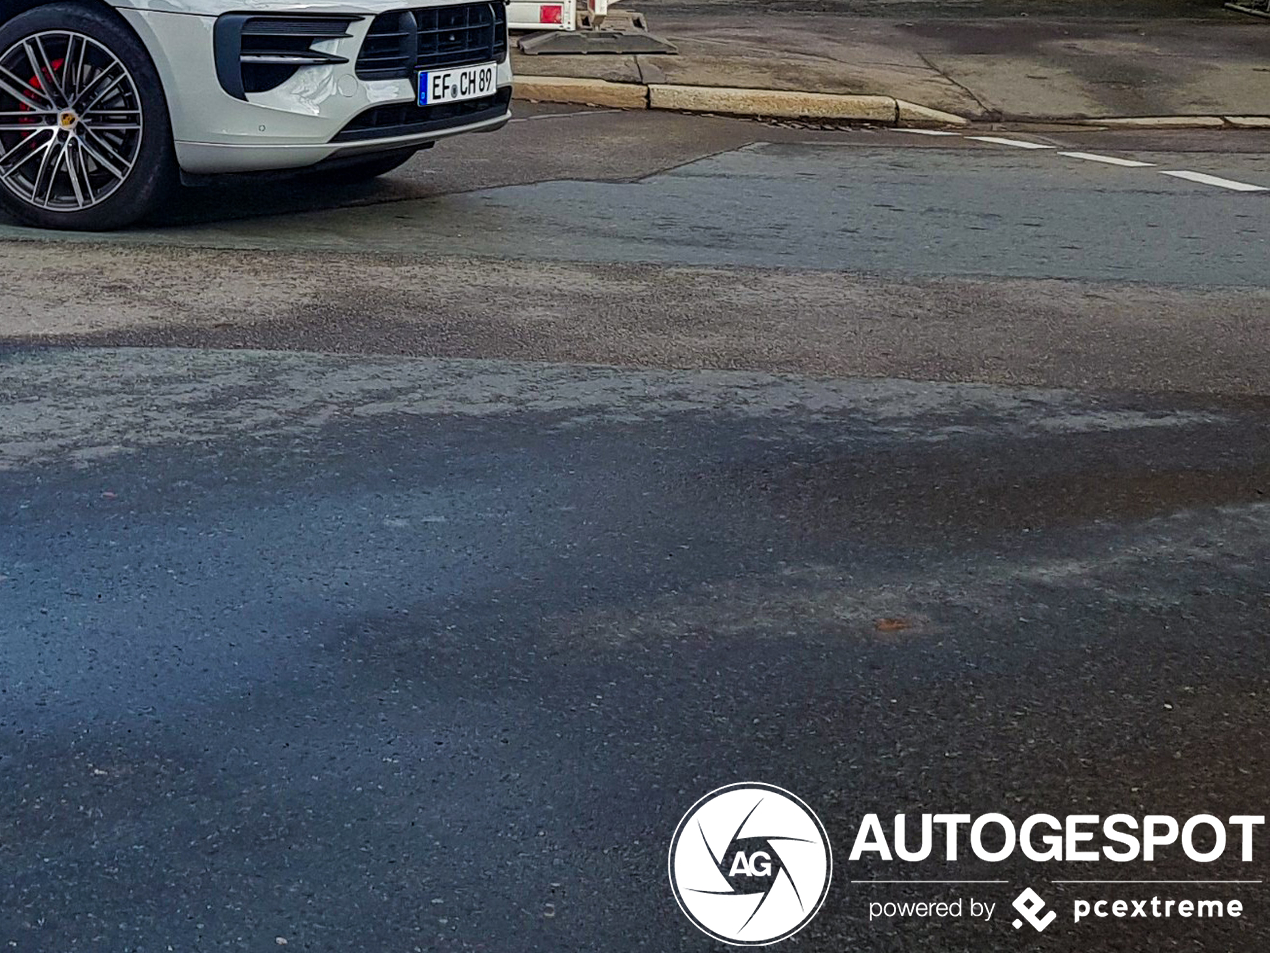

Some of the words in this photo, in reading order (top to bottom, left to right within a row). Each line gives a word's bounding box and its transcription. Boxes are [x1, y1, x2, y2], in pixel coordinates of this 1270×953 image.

[432, 73, 452, 101] EF
[459, 69, 477, 96] CH
[478, 67, 493, 93] 89
